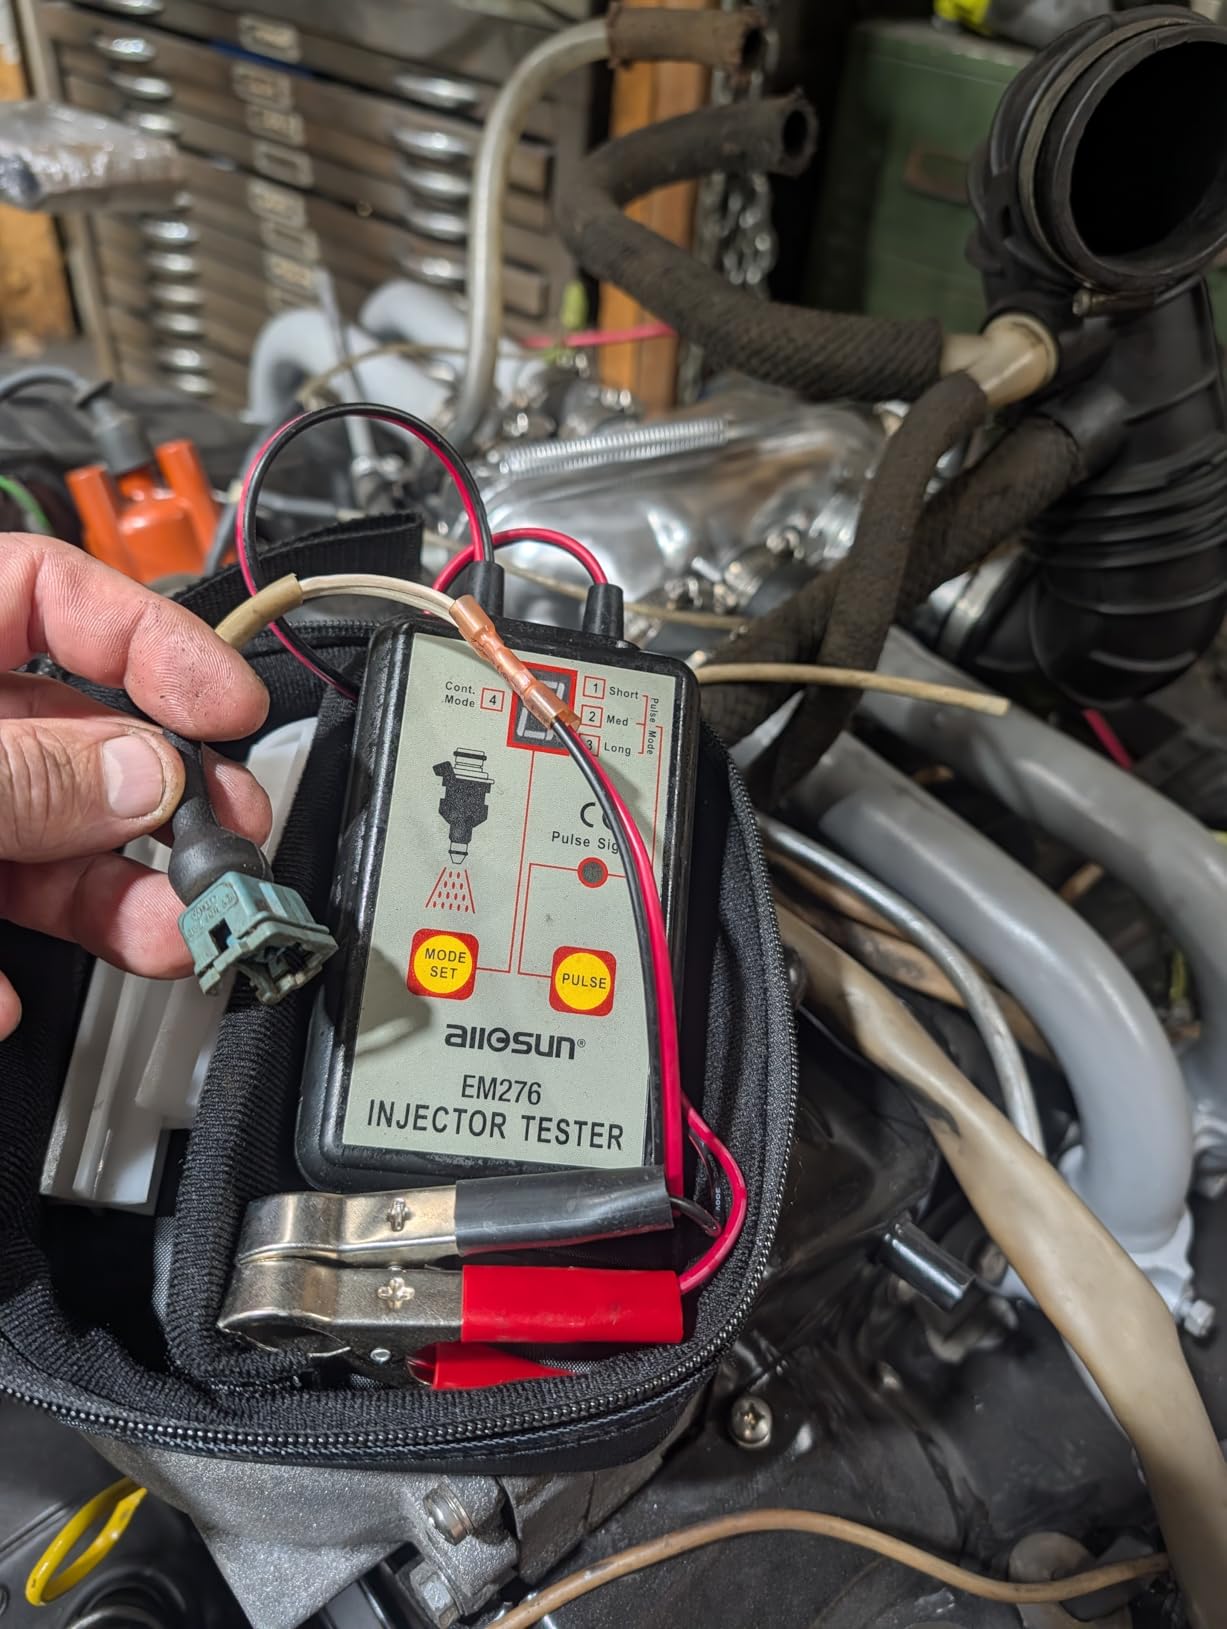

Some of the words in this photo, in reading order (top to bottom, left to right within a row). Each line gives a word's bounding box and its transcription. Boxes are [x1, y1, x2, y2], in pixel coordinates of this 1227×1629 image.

[444, 681, 475, 694] Cont.
[609, 686, 639, 699] Short
[445, 694, 475, 707] Mode
[489, 695, 497, 705] 4
[649, 697, 659, 723] Pulse
[589, 711, 596, 722] 2
[606, 714, 629, 726] Med
[586, 740, 593, 751] 3
[604, 742, 631, 757] Long
[647, 730, 656, 755] Mode
[551, 831, 590, 847] Pulse
[597, 837, 620, 854] Sig
[425, 948, 467, 964] MODE
[430, 966, 458, 979] SET
[562, 973, 607, 989] PULSE
[461, 1074, 541, 1105] EM276
[367, 1099, 506, 1139] INJECTOR
[521, 1114, 624, 1151] TESTER
